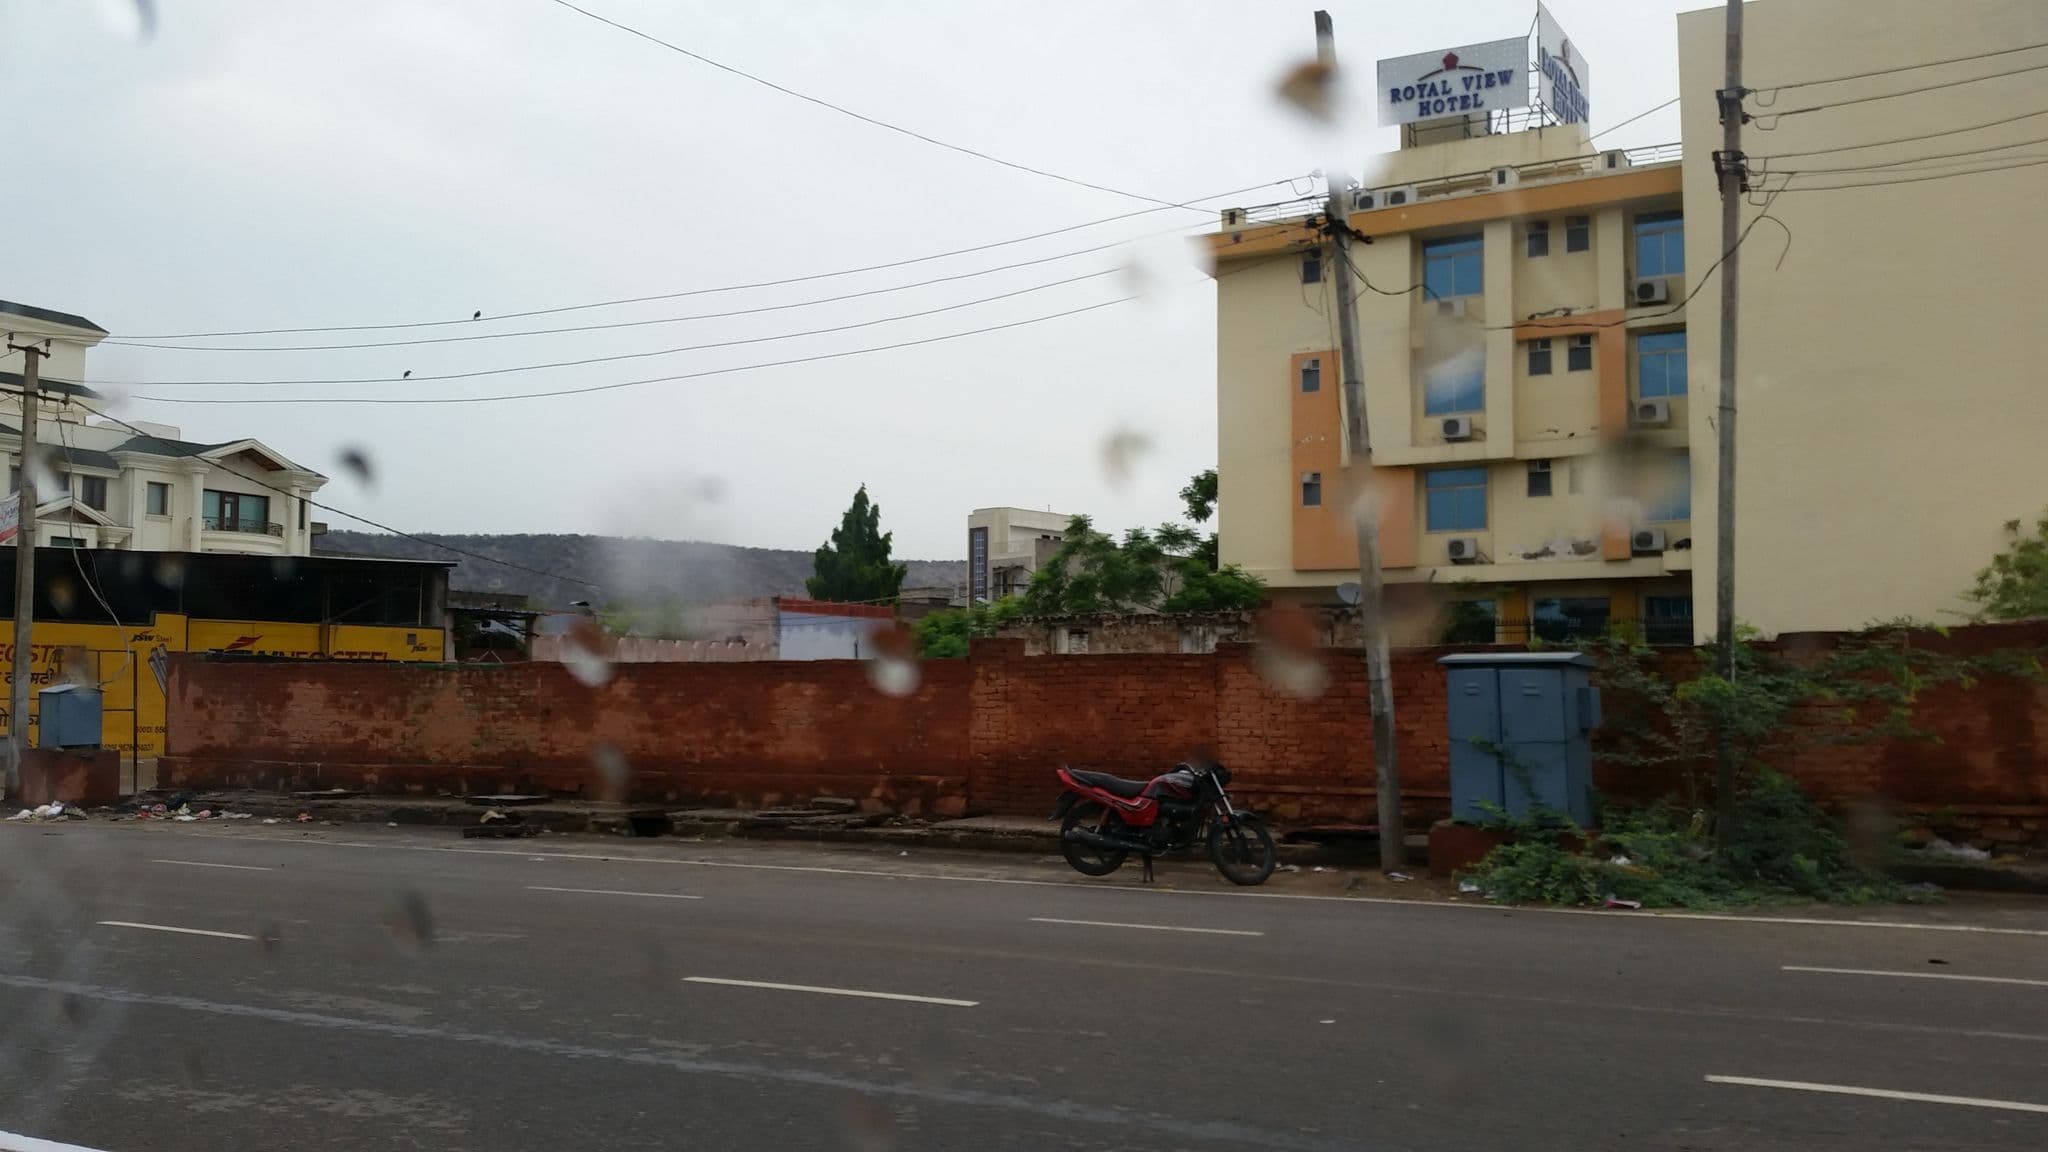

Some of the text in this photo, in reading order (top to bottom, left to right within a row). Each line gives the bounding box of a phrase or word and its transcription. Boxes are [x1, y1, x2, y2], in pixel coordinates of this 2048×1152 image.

[1390, 69, 1515, 104] ROYAL VIEW
[1419, 93, 1484, 117] HOTEL
[130, 632, 155, 642] JSW
